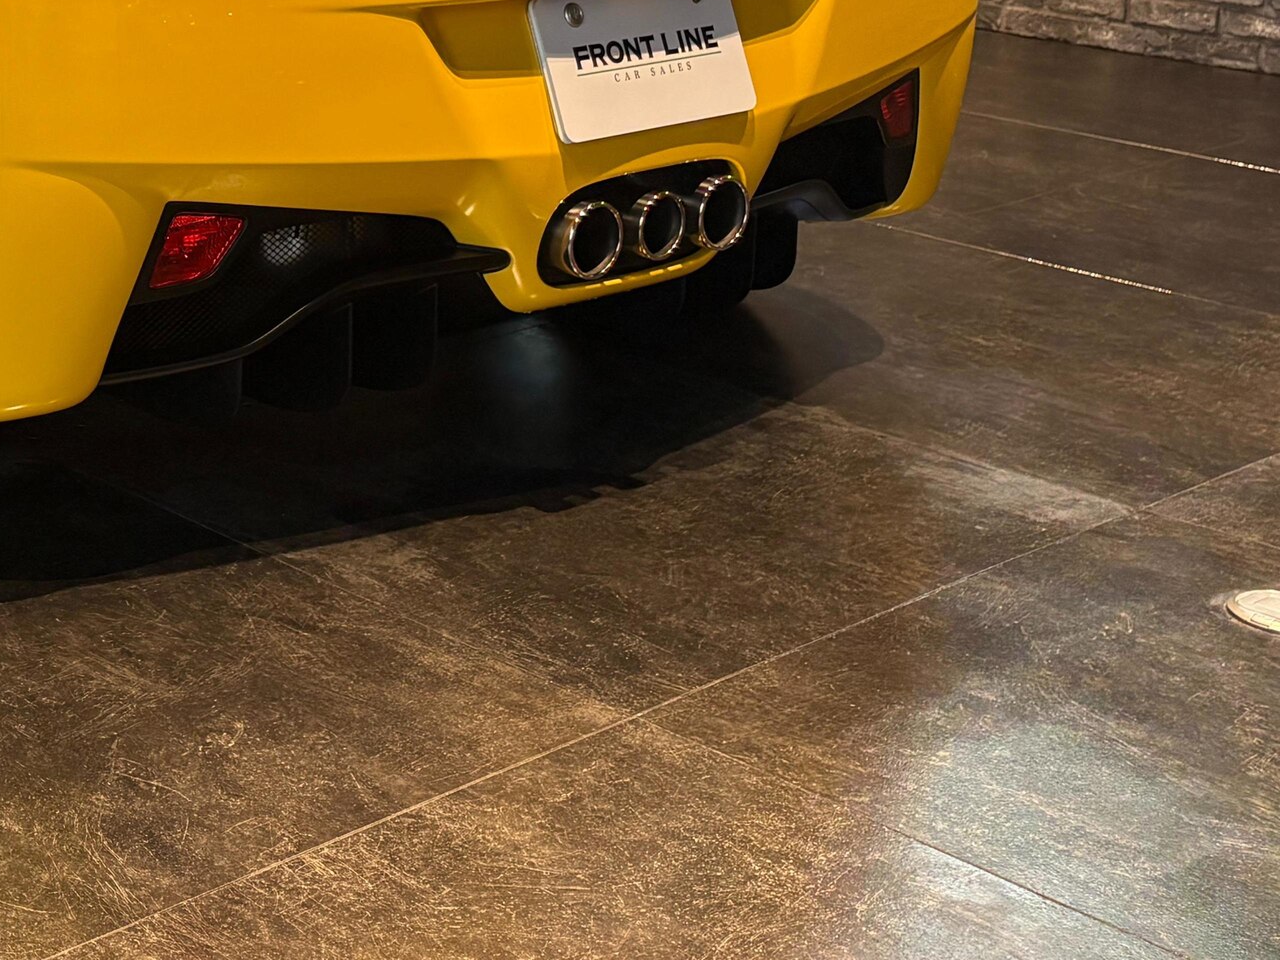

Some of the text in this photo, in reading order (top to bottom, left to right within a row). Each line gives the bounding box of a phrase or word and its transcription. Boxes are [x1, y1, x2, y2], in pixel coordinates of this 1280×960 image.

[573, 25, 719, 70] FRONT LINE
[614, 61, 693, 83] CAR SALES
